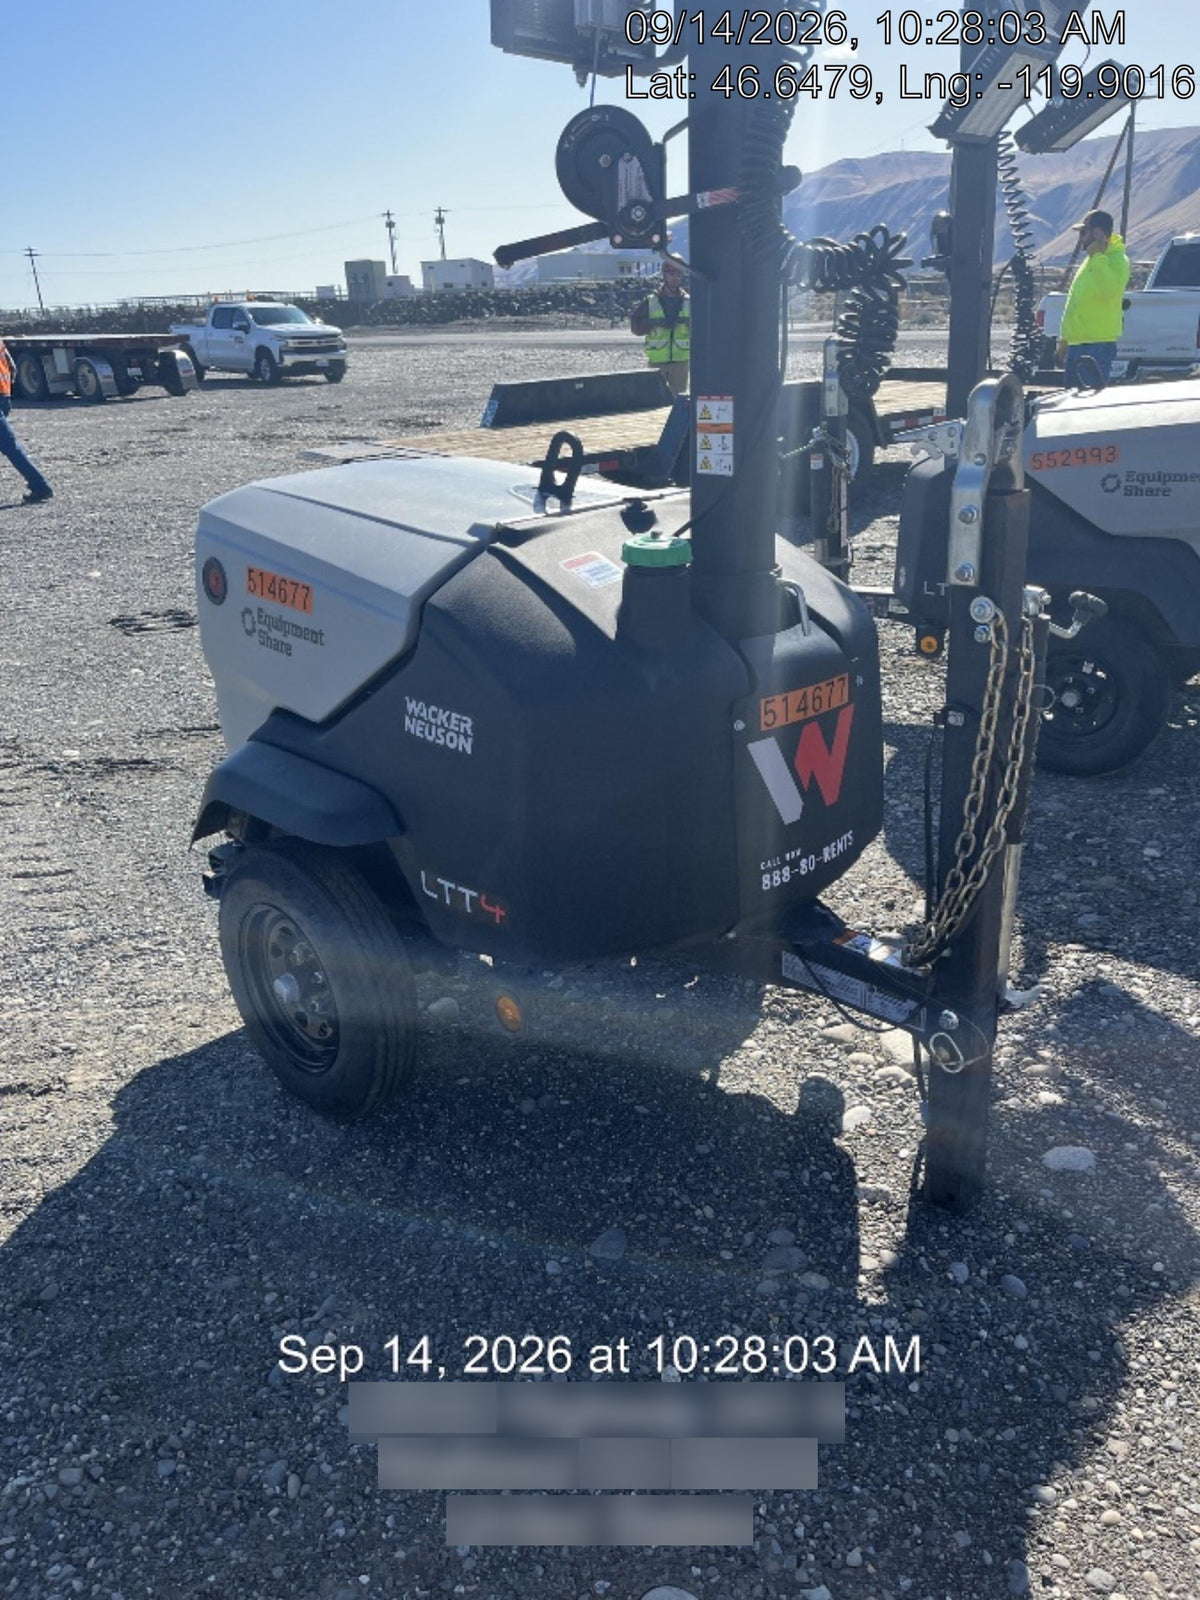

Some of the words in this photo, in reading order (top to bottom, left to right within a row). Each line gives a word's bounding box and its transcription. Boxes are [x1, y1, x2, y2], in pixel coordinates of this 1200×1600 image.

[1032, 446, 1117, 470] 552993
[1125, 470, 1200, 485] Equipme
[1123, 485, 1171, 497] Share
[247, 568, 310, 610] 514677
[923, 580, 950, 597] LT
[257, 606, 325, 647] Equipment
[258, 628, 293, 657] Share
[404, 696, 474, 737] WACKER
[763, 676, 847, 728] 514677
[404, 714, 474, 755] NEUSON
[761, 829, 854, 891] 888-80-RENTS
[420, 870, 506, 924] LTT4
